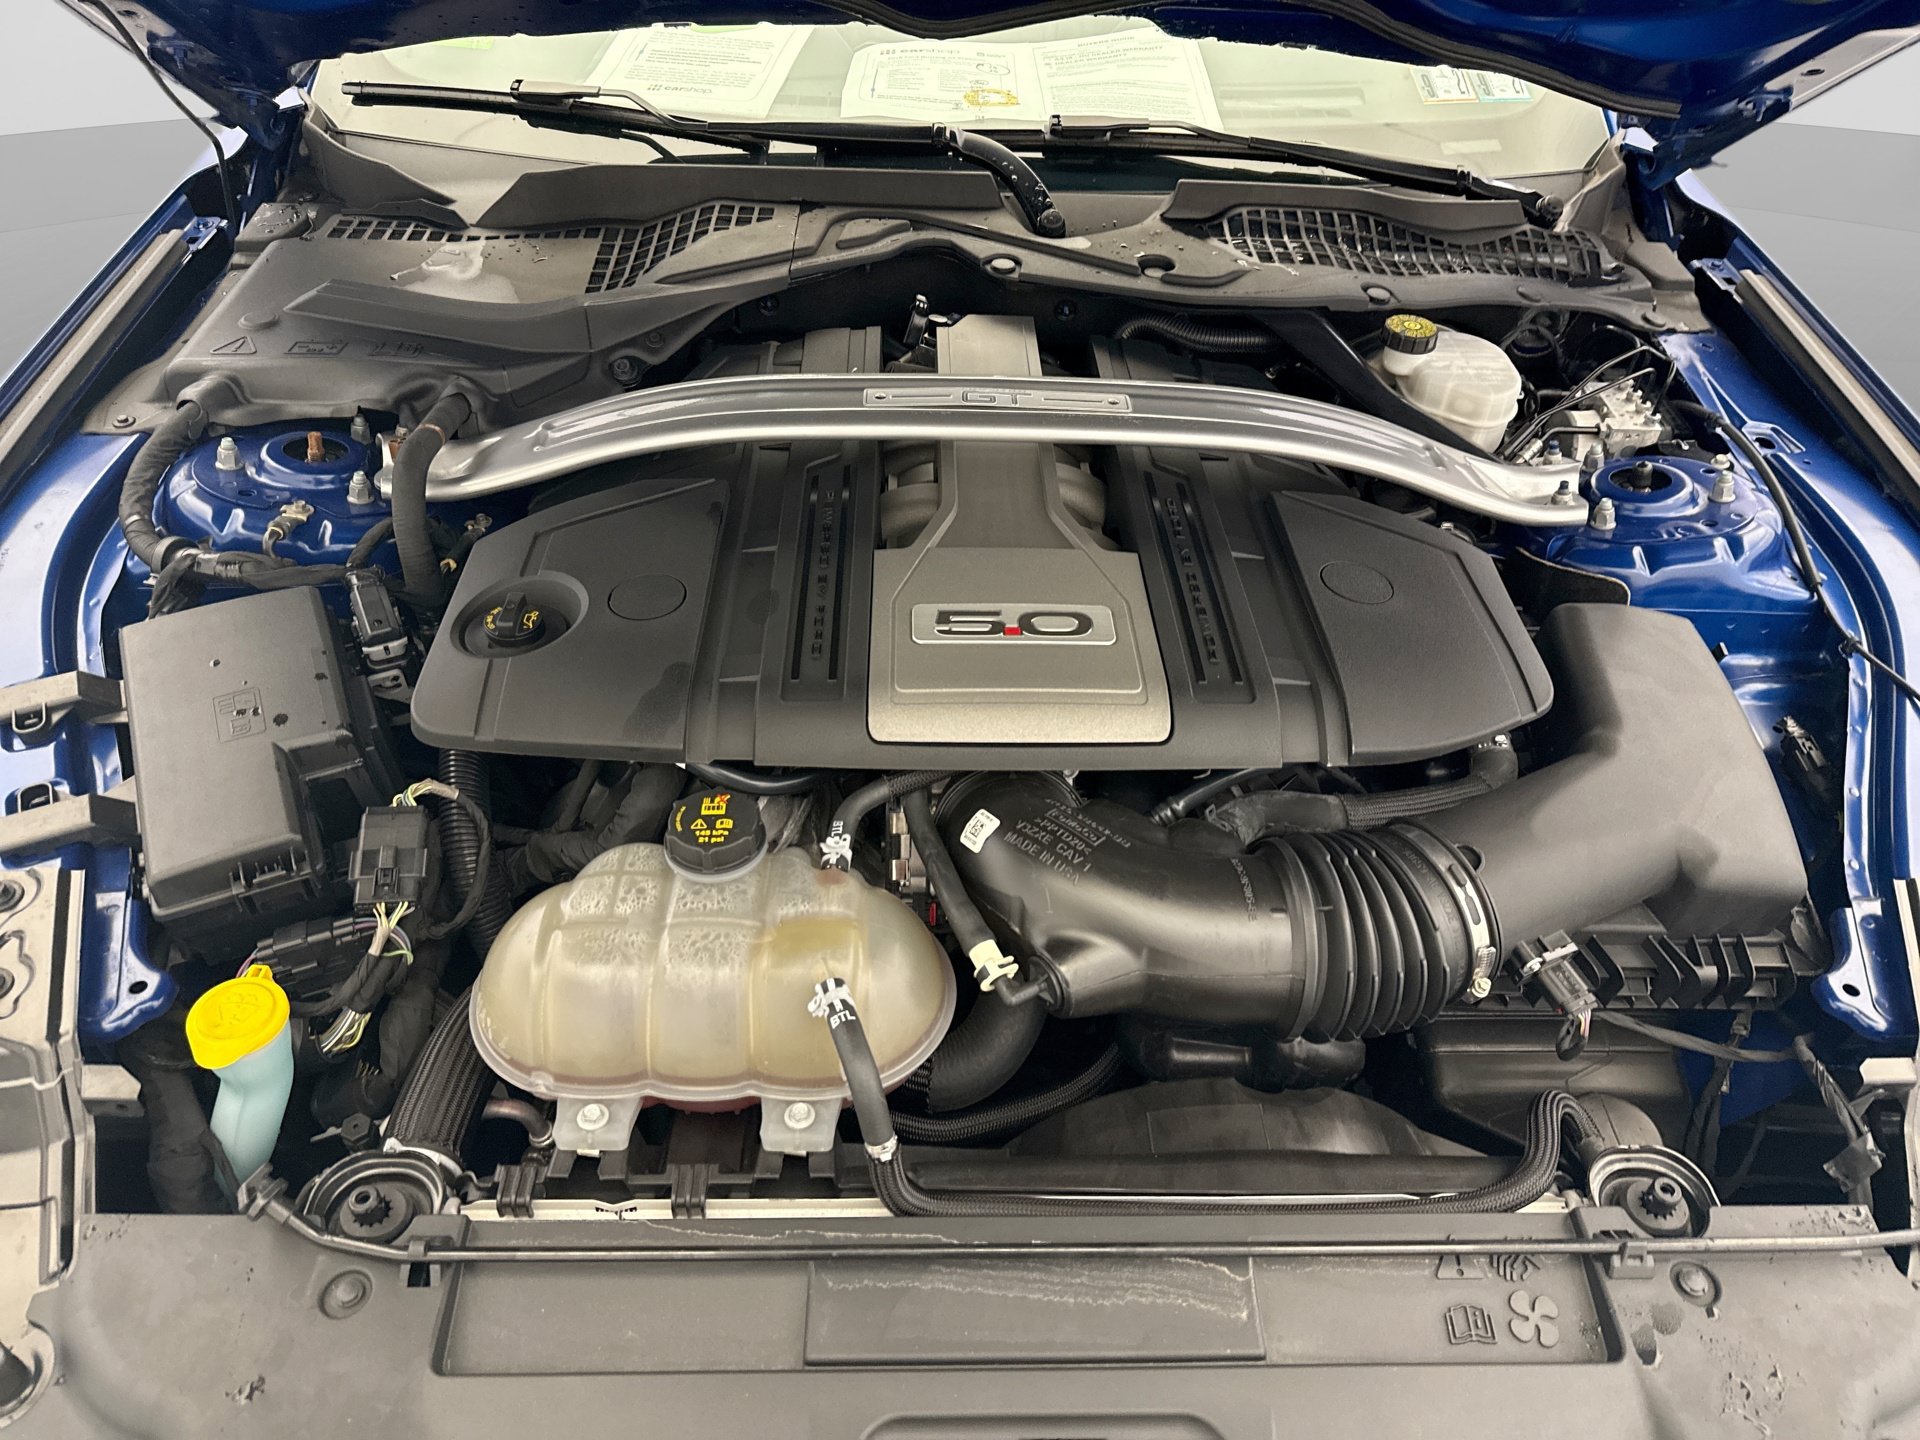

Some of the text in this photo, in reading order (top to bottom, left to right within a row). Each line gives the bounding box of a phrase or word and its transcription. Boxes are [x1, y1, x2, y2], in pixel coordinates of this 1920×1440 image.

[664, 86, 713, 95] carshop
[962, 391, 1033, 406] GT
[932, 608, 1094, 637] 5.0
[1185, 571, 1220, 664] POWERED
[831, 820, 844, 838] BTL
[711, 836, 724, 844] psi
[1003, 831, 1040, 856] MADE
[1039, 850, 1055, 866] IN
[1054, 860, 1079, 885] USA
[1056, 842, 1084, 865] CAV
[830, 1010, 856, 1029] BTL
